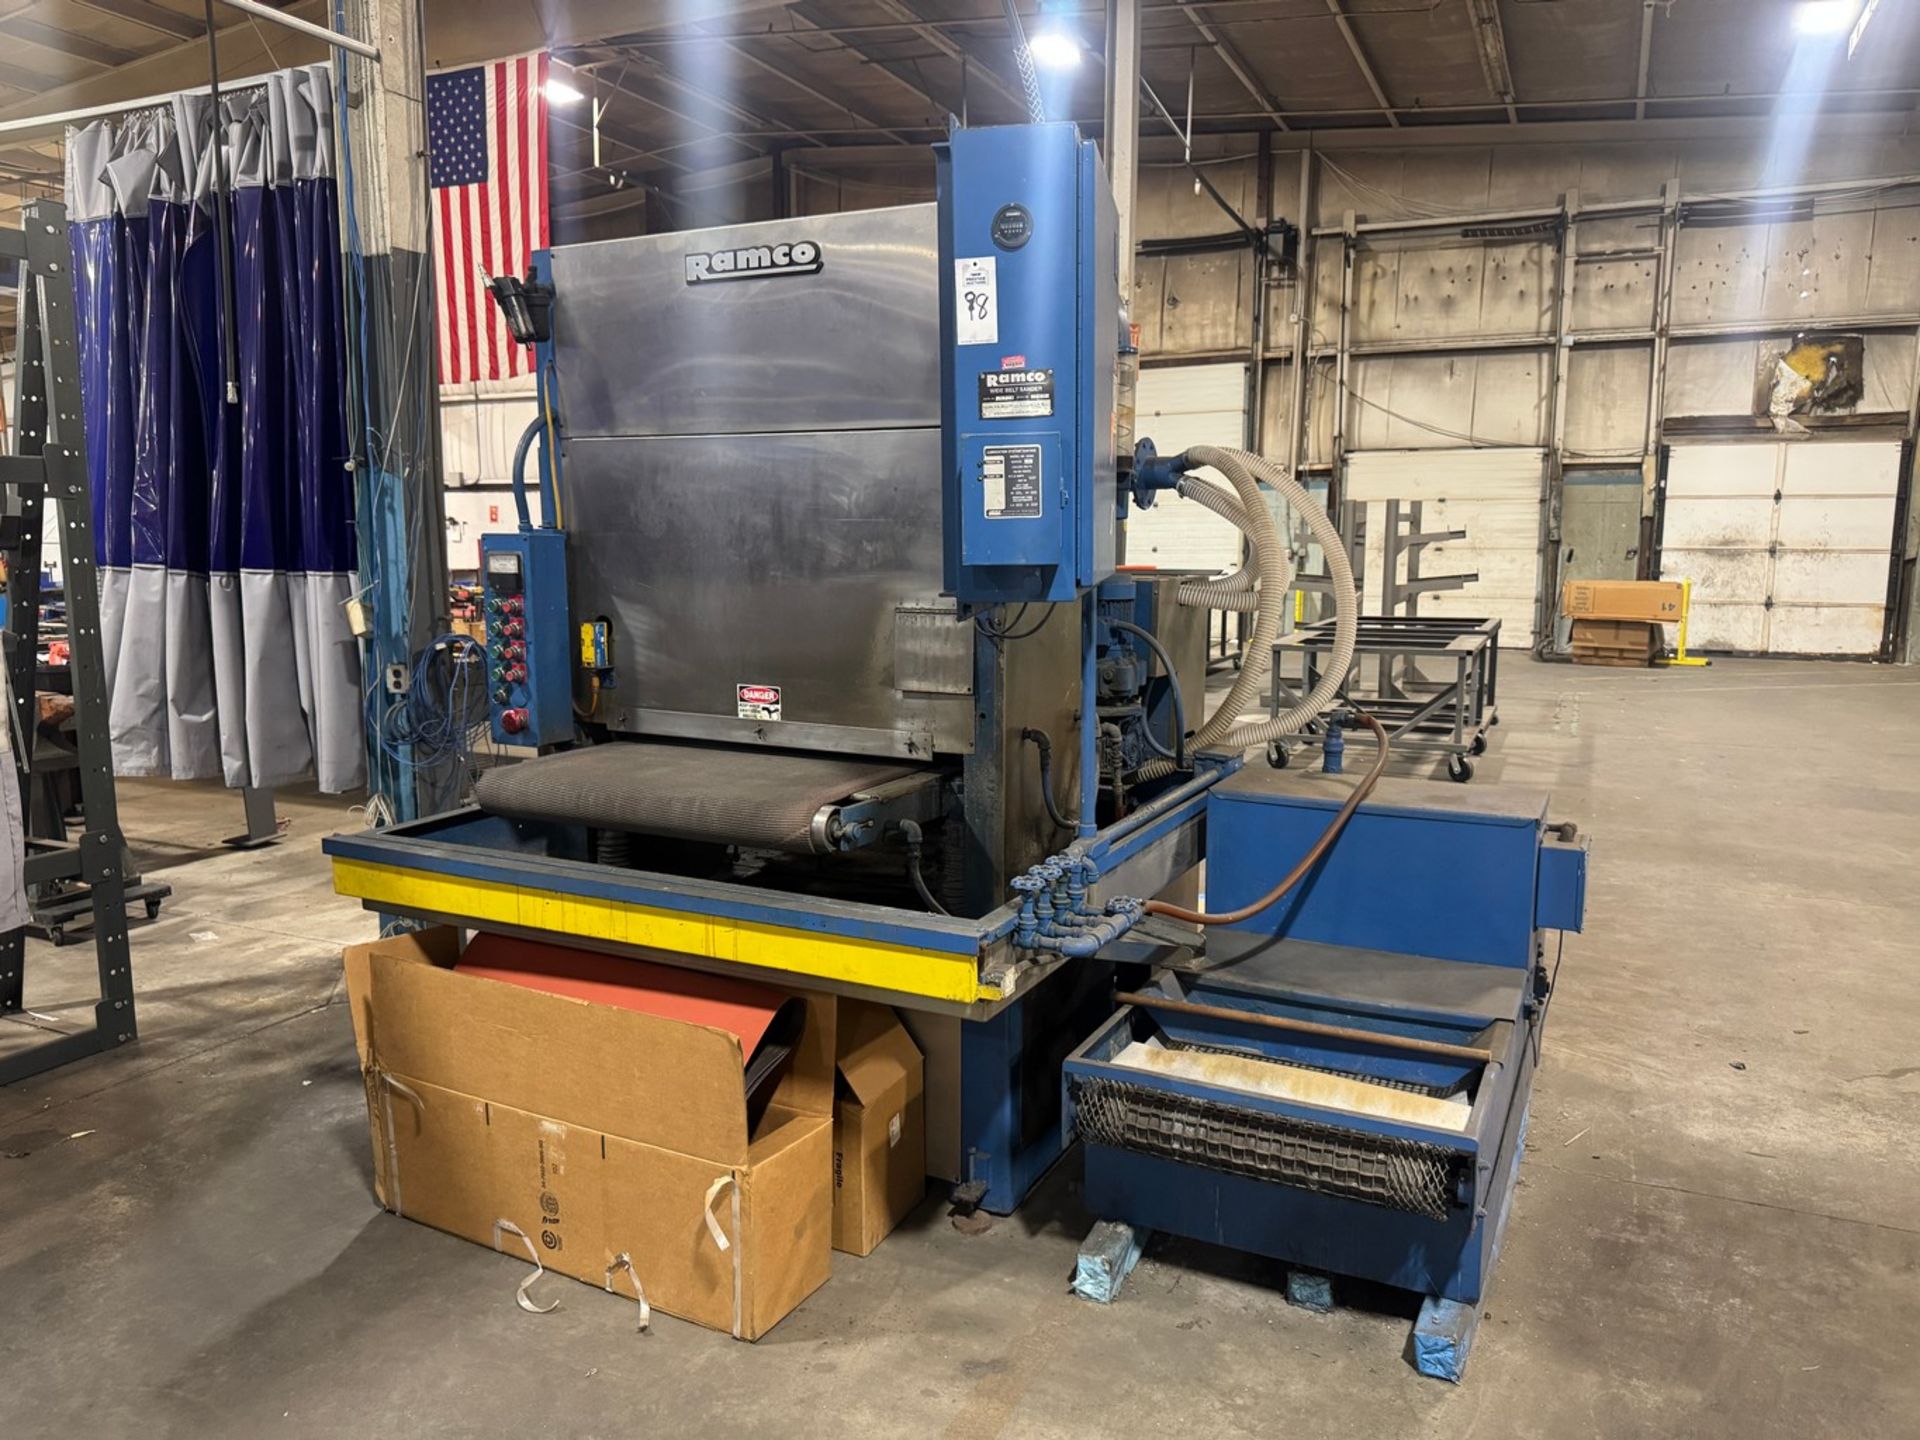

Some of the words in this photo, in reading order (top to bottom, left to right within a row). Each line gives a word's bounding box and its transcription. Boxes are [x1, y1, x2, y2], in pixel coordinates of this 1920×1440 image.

[685, 242, 817, 281] Ramco
[964, 291, 989, 321] 98
[986, 371, 1046, 388] Ramco
[743, 690, 775, 701] DANGER
